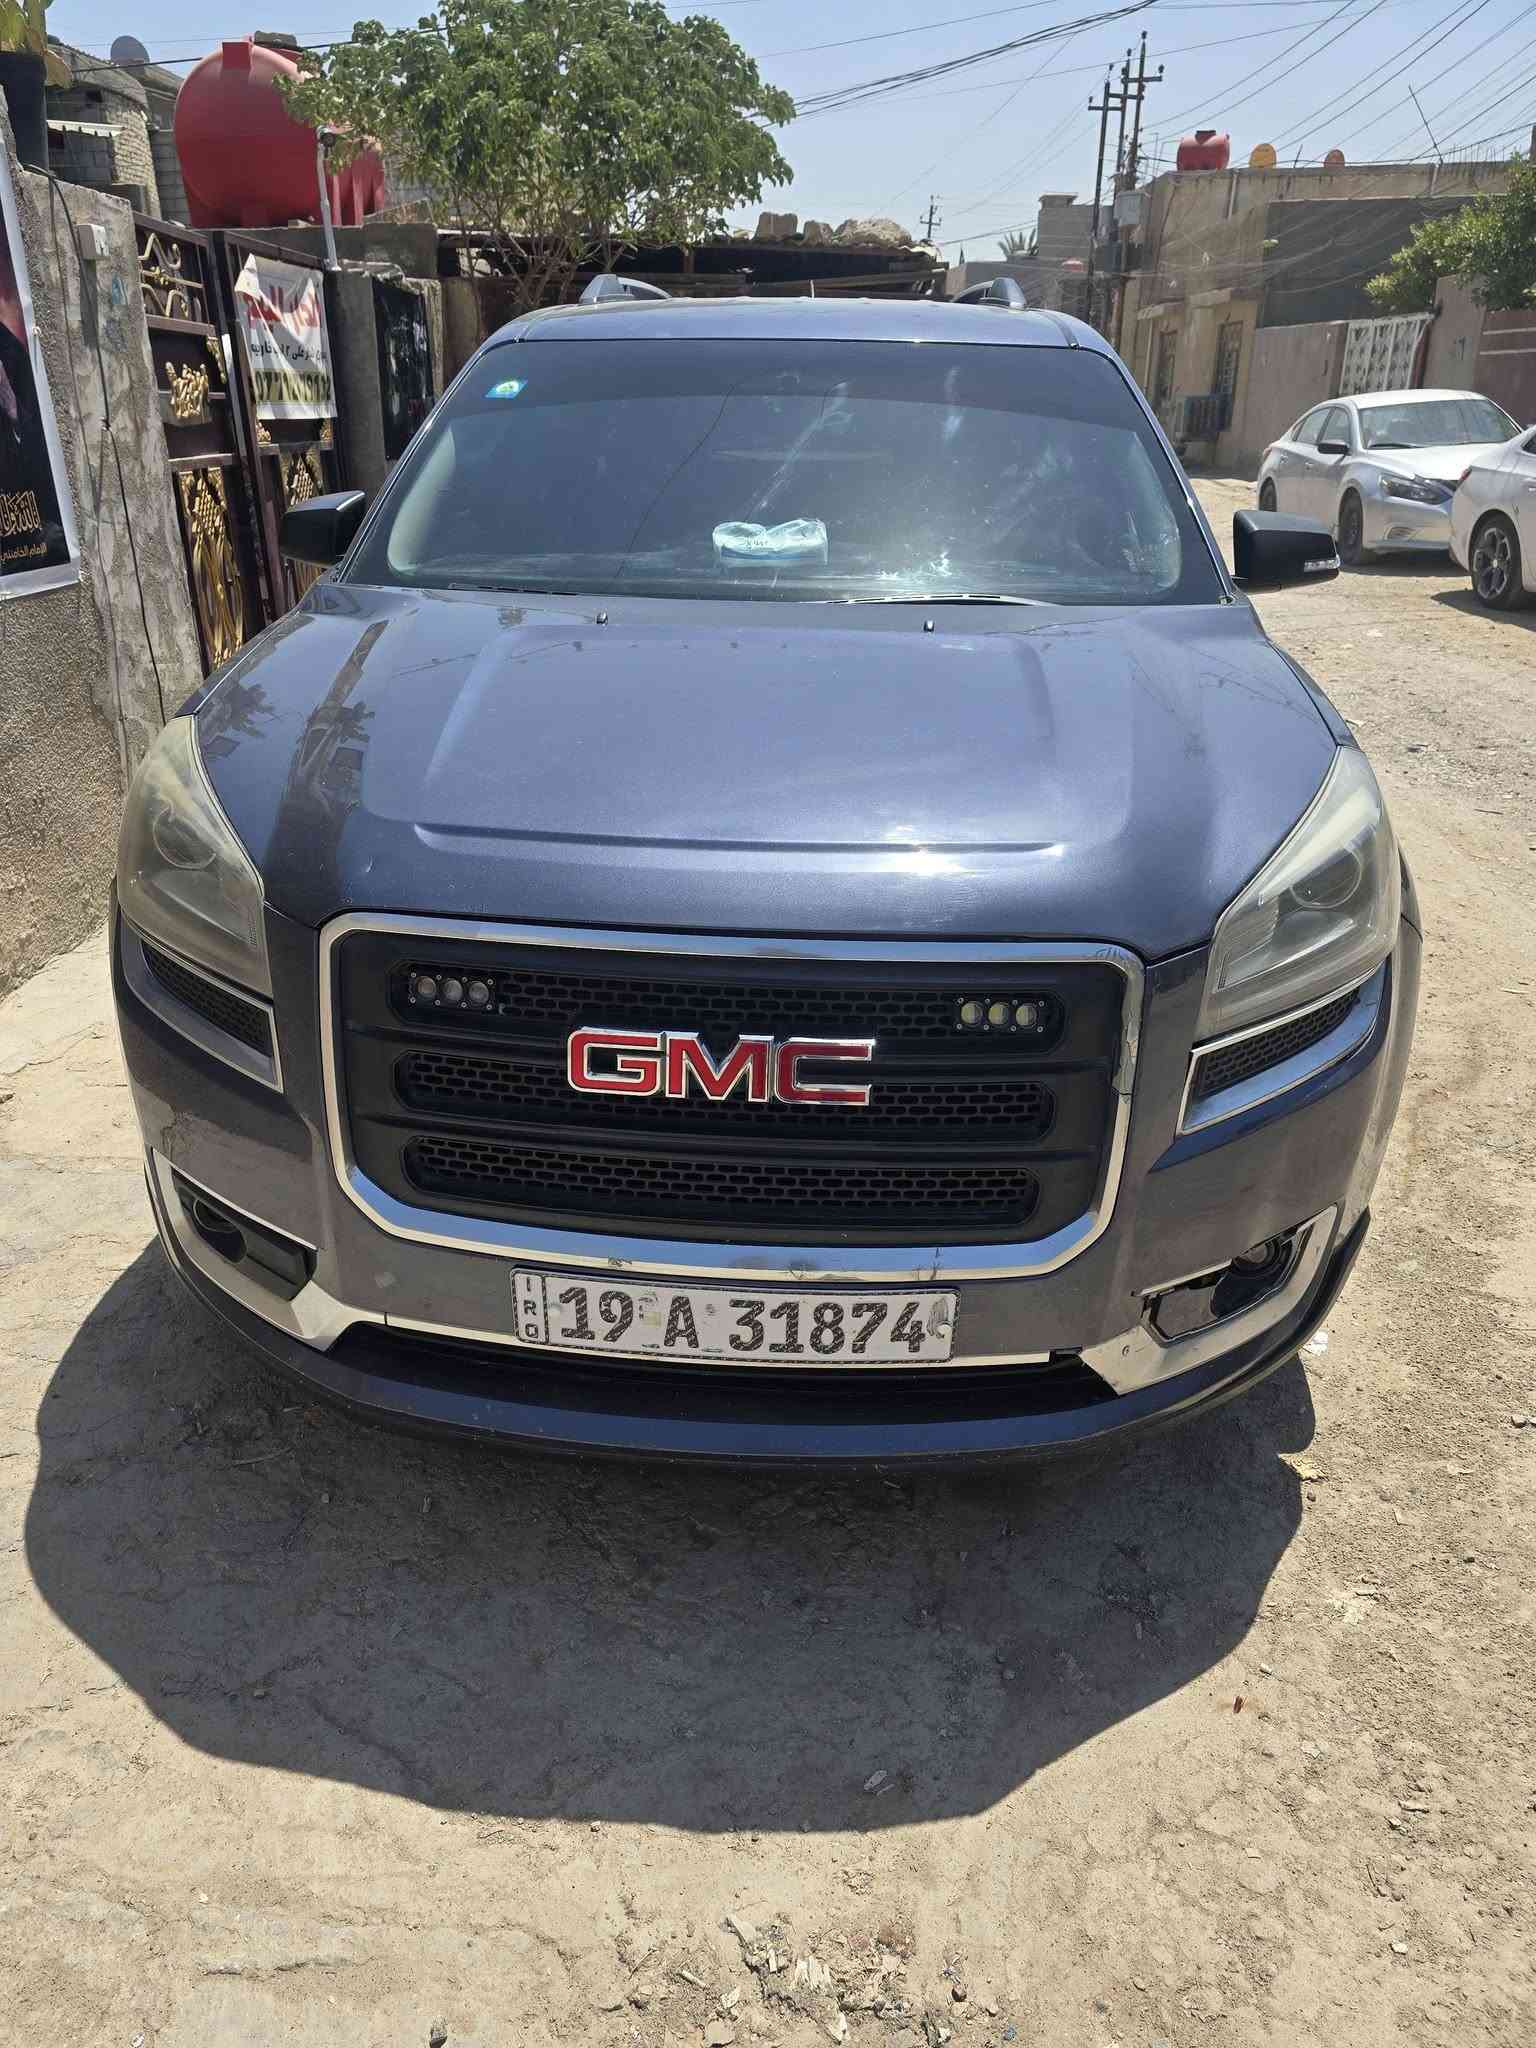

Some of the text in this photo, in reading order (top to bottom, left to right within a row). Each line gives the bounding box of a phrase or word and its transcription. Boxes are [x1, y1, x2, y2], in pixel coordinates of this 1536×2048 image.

[567, 1026, 875, 1106] GMC
[559, 1286, 926, 1355] 19 A 31874
